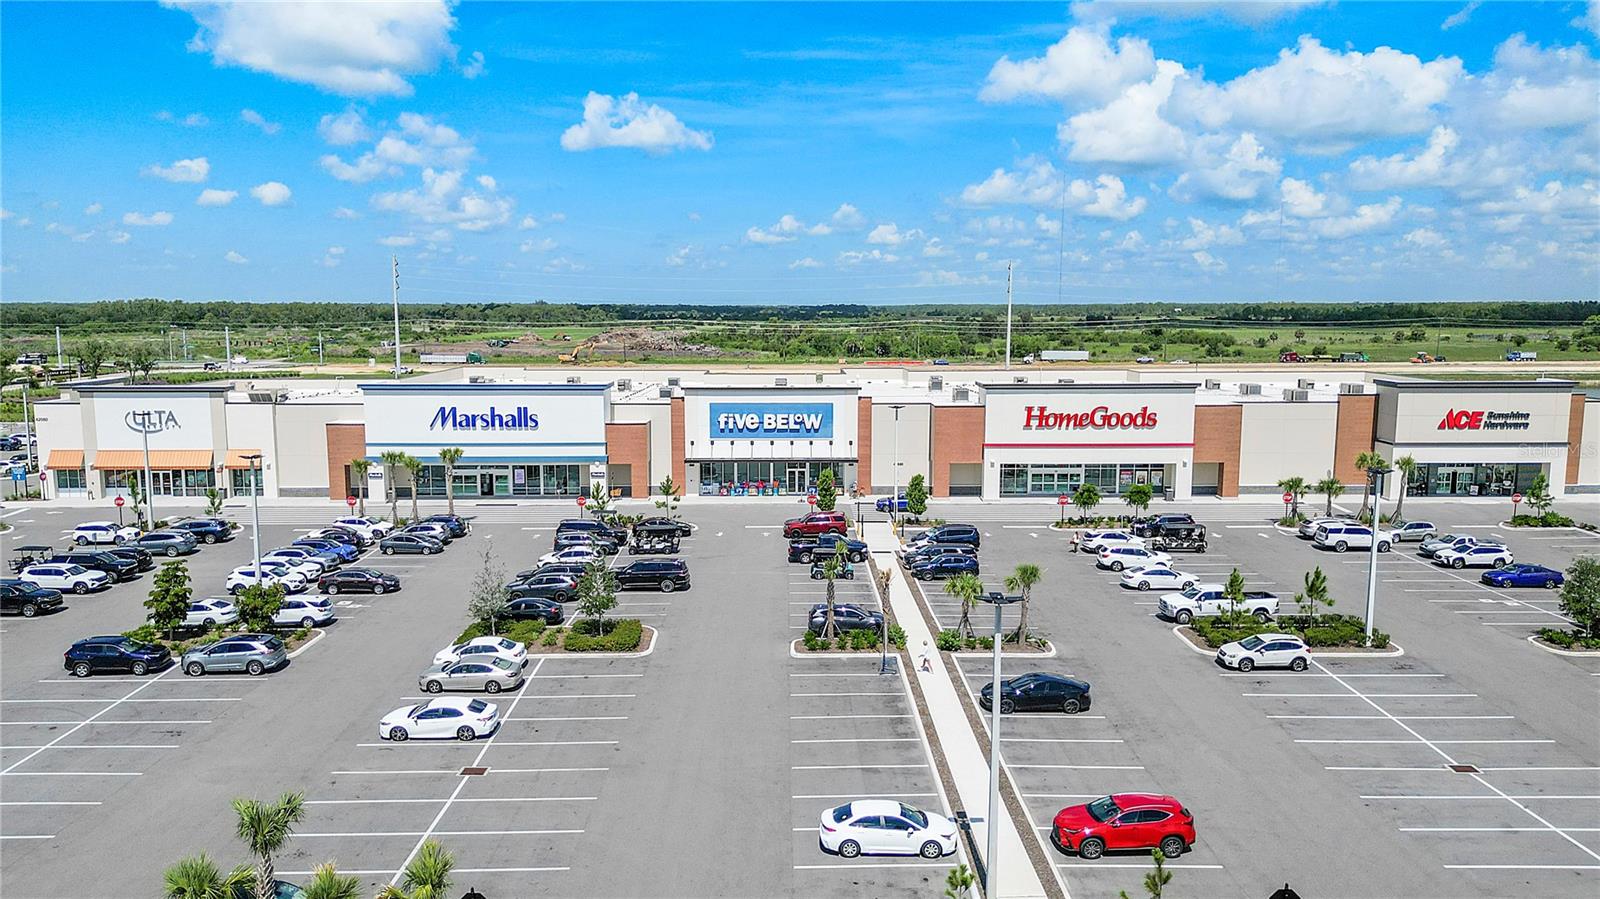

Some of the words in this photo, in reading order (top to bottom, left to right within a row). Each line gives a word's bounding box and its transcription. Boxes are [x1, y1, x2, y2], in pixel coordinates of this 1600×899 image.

[132, 410, 179, 426] ULTA
[430, 406, 539, 430] Marshalls
[1023, 405, 1158, 429] HomeGoods
[1437, 408, 1485, 430] ACE
[1483, 420, 1530, 430] Hardware
[1487, 411, 1530, 421] Sunshine
